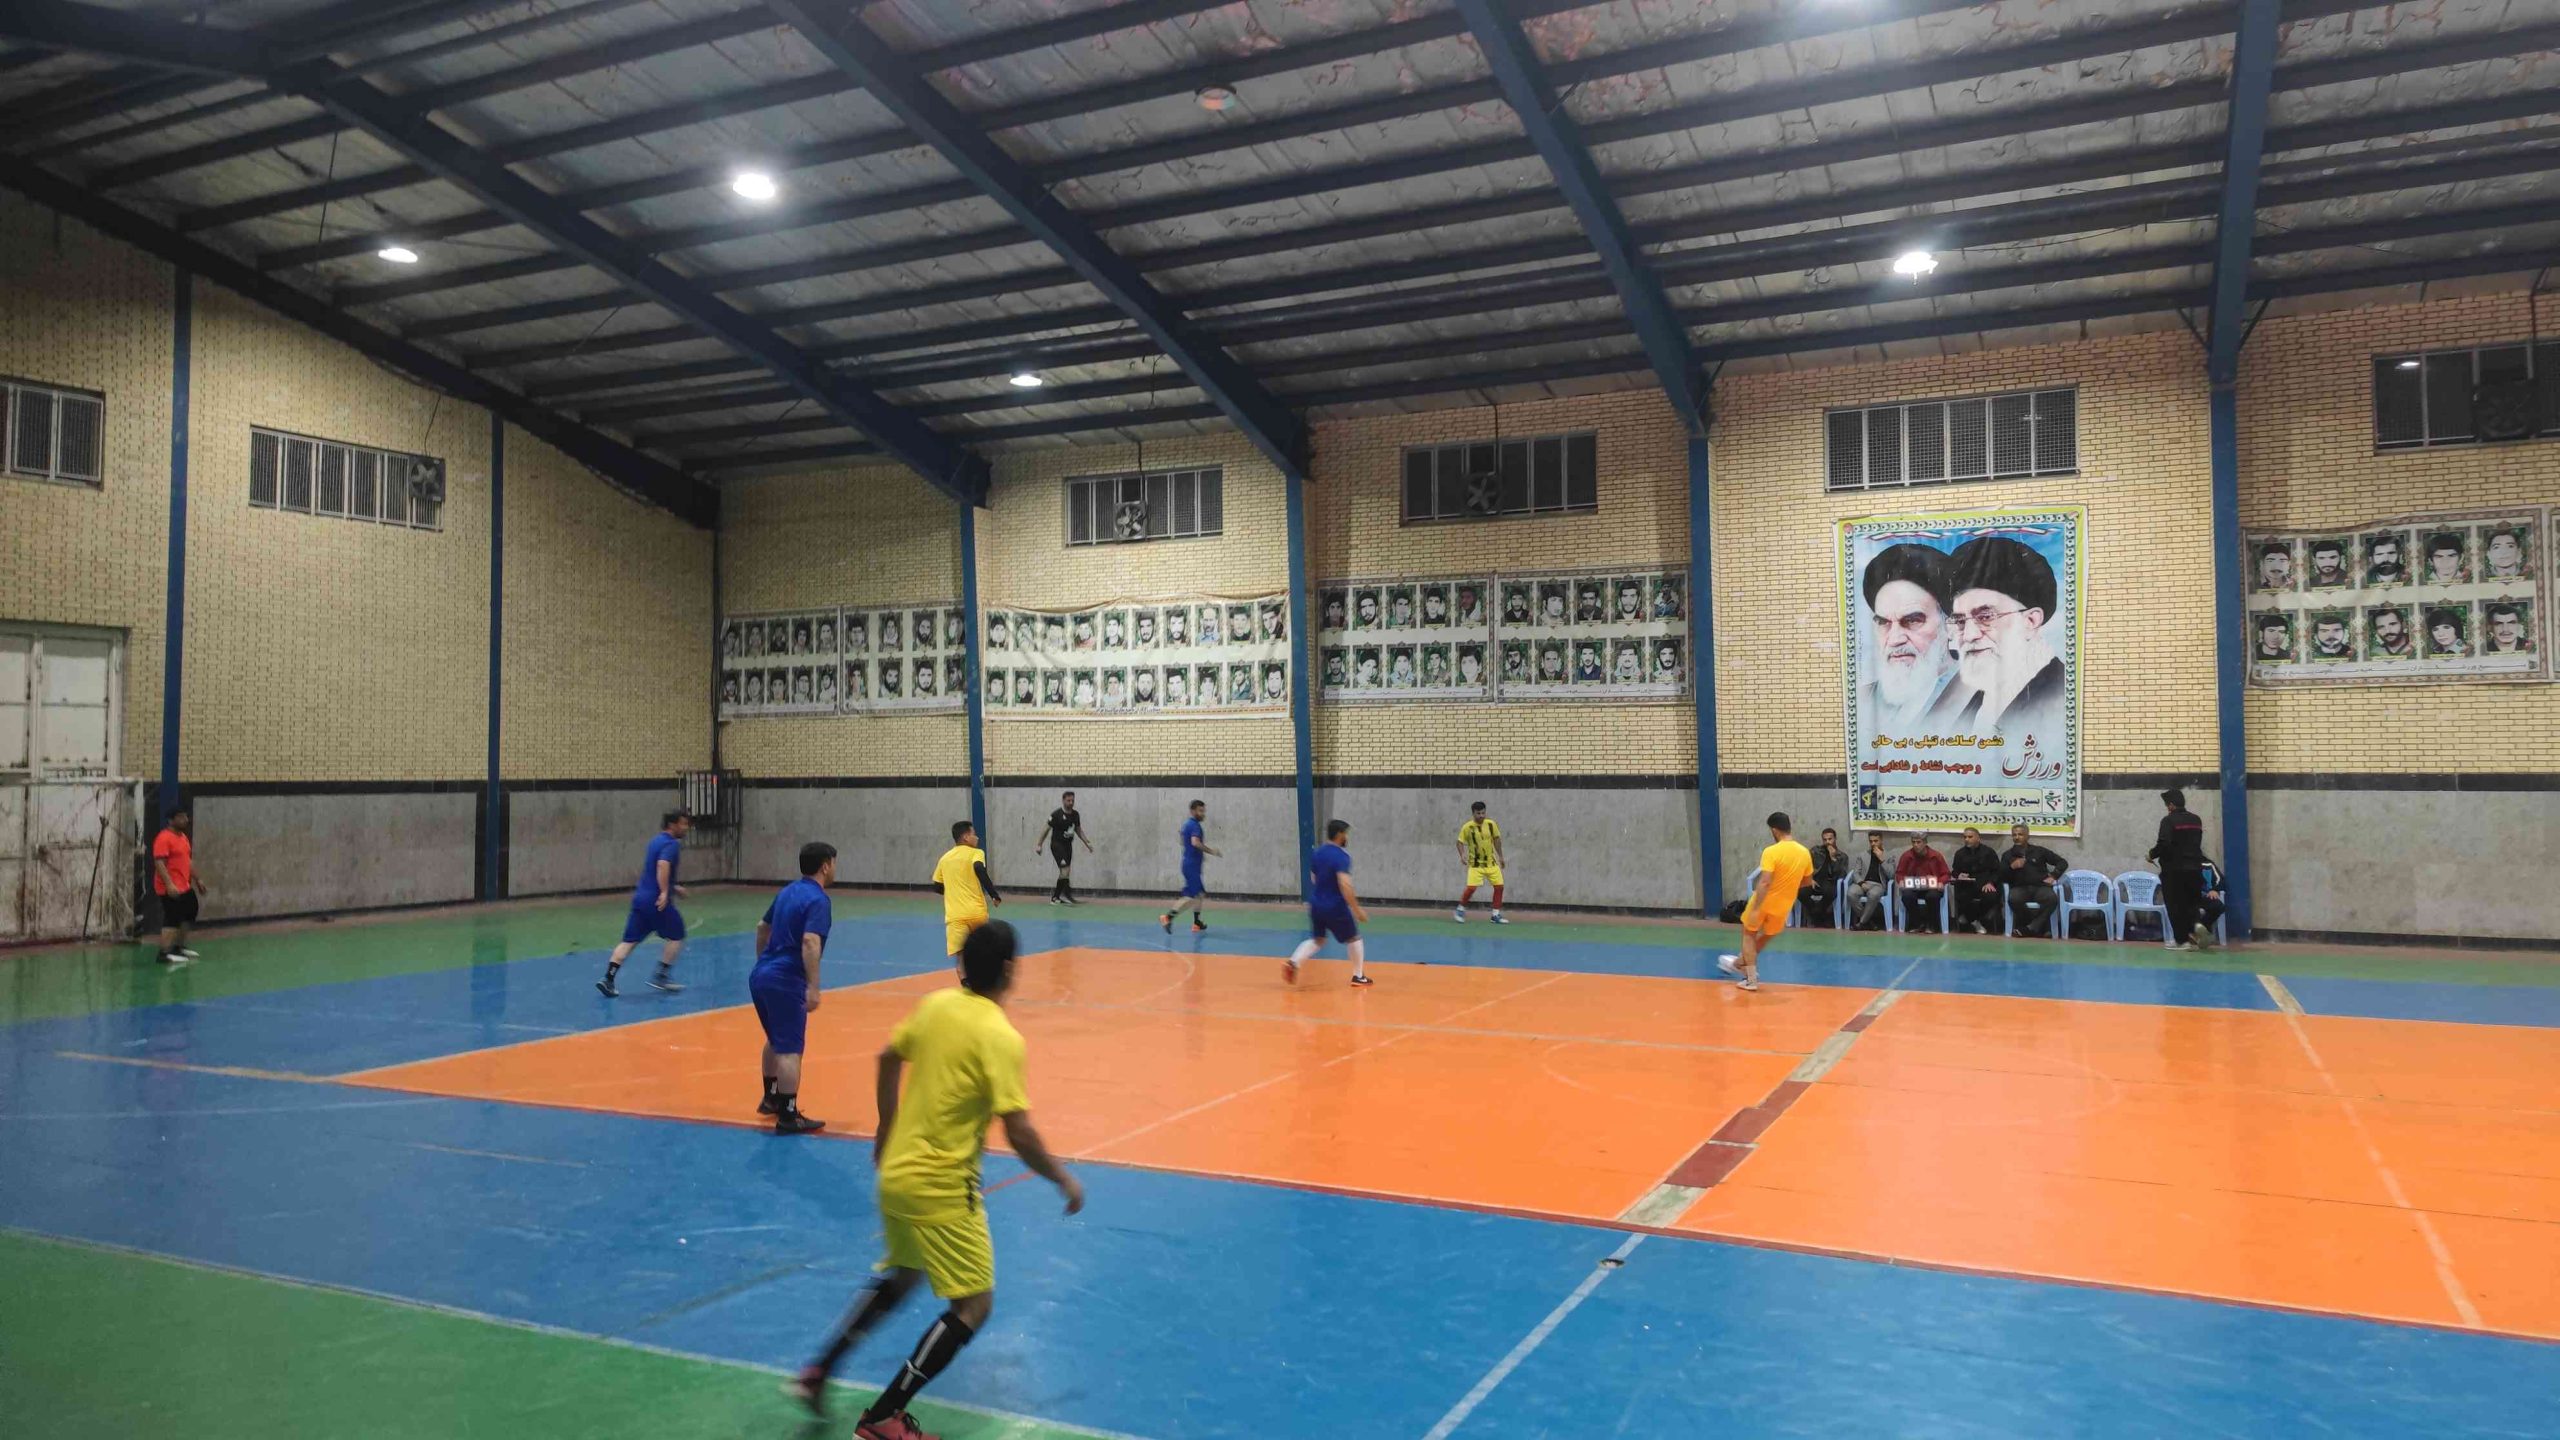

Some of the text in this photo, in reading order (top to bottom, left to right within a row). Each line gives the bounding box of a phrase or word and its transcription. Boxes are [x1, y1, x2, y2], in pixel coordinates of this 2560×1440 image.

[1977, 734, 2004, 749] دشمن
[2001, 732, 2063, 780] ورزش
[1879, 760, 1910, 774] شادابی
[1911, 763, 1918, 774] و
[1919, 760, 1943, 771] نشاط
[1944, 763, 1974, 774] موجب
[1974, 763, 1982, 774] و
[1898, 794, 1918, 805] بسیج
[1919, 793, 1949, 806] مقاومت
[1951, 794, 1972, 805] ناحیه
[1973, 794, 2018, 807] ورزشکاران
[2020, 796, 2040, 807] بسیج
